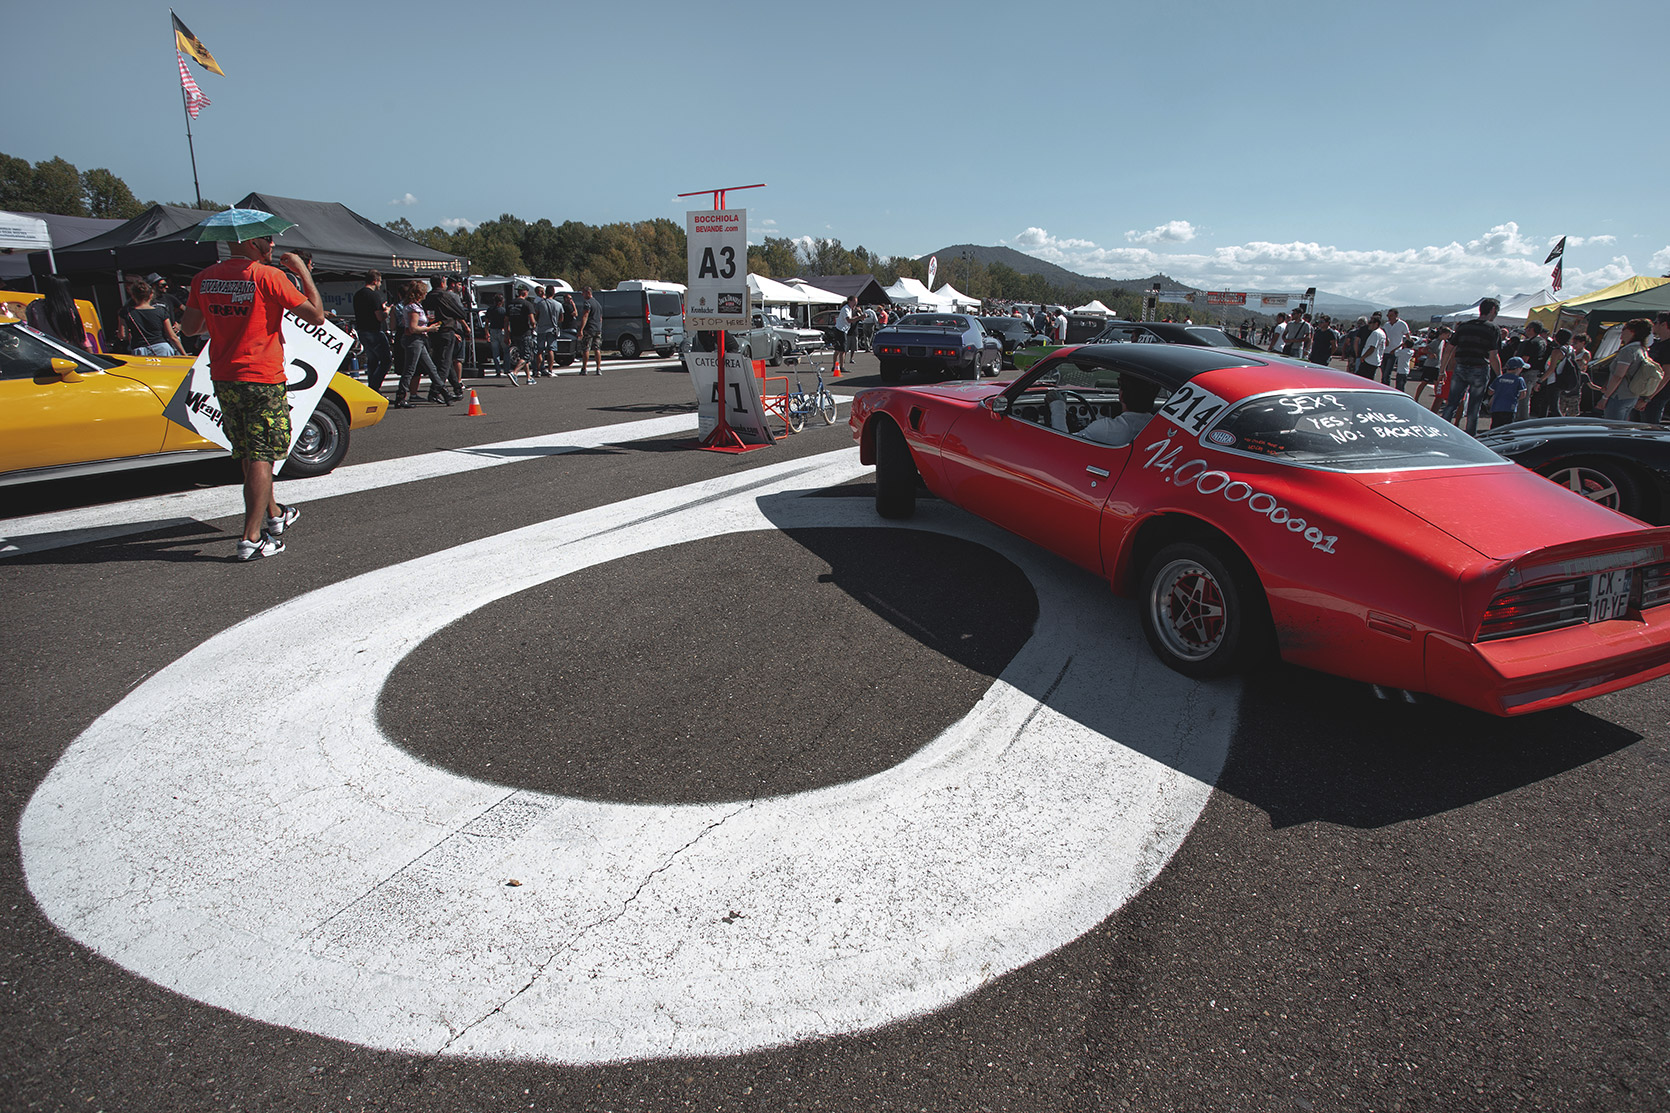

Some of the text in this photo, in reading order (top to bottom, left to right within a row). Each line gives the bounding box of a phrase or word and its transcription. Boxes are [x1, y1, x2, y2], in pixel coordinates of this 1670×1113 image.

[694, 214, 739, 223] BOCCHIOLA
[695, 225, 723, 233] BEVANDE
[698, 246, 736, 279] A3
[208, 304, 250, 317] CREW
[691, 317, 748, 327] STOP HERE!
[283, 310, 345, 355] EGORIA
[695, 357, 741, 368] CATEGRIA
[1162, 386, 1222, 432] 214
[1278, 394, 1347, 415] SEX?
[1306, 416, 1353, 430] YES:
[1211, 430, 1235, 444] NHRA
[1329, 429, 1365, 444] NO:
[1596, 571, 1614, 596] CX
[1591, 598, 1607, 623] 10
